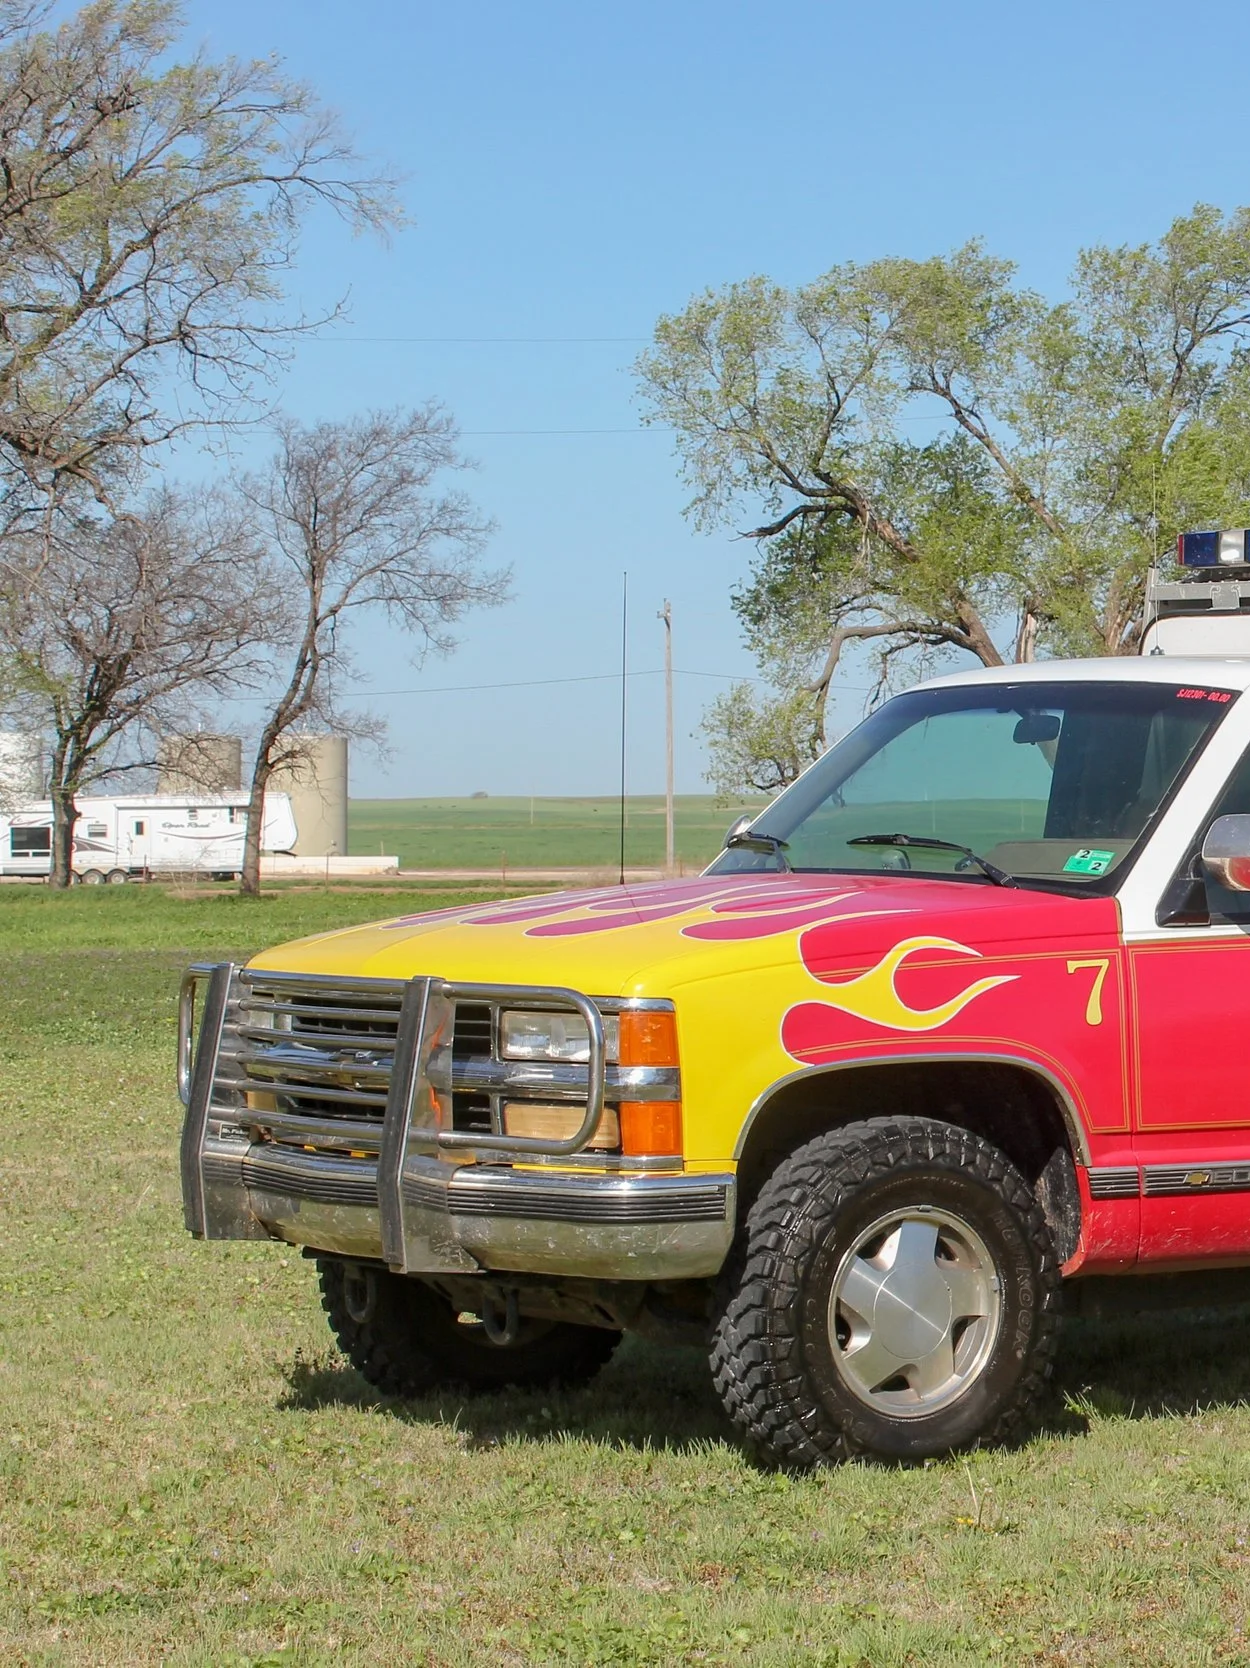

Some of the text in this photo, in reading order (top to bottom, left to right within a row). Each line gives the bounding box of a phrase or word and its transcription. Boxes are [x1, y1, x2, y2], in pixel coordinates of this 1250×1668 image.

[1080, 849, 1091, 859] 2
[1091, 862, 1102, 871] 2
[1066, 958, 1110, 1026] 7
